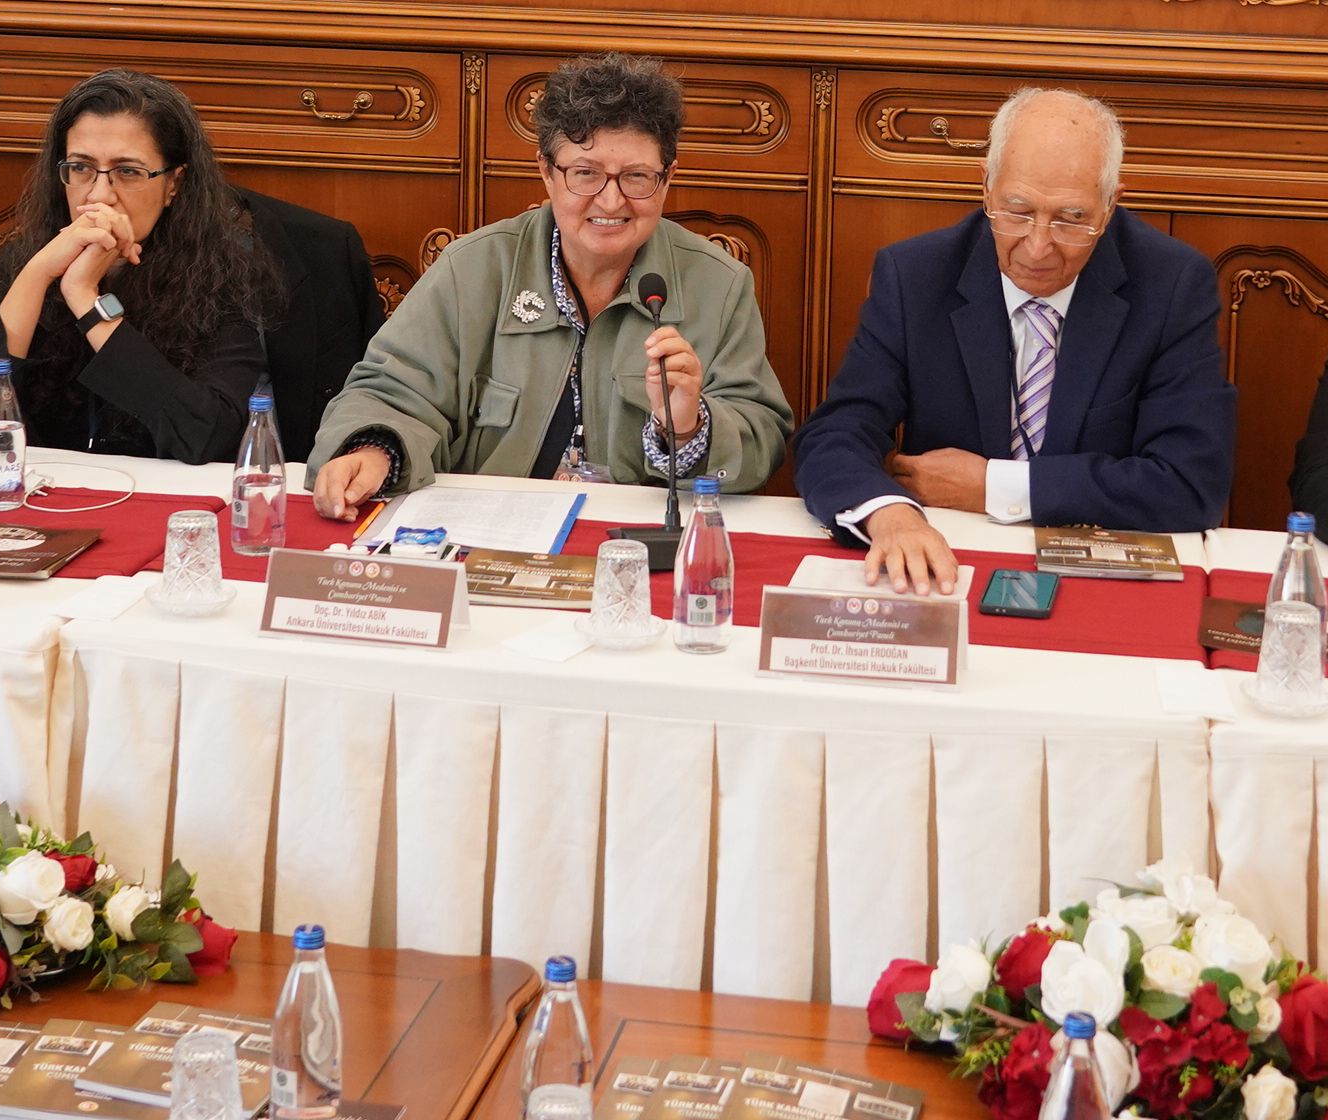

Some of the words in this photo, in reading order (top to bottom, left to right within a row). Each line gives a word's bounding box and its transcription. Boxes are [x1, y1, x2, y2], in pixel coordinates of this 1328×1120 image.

[314, 605, 330, 616] Doç.
[333, 606, 344, 616] Dr.
[286, 616, 314, 628] Ankara
[316, 619, 365, 632] Üniversitesi
[366, 623, 390, 634] Hukuk
[391, 625, 428, 639] Fakültesi
[811, 644, 830, 654] Prof.
[832, 645, 843, 655] Dr.
[845, 644, 869, 656] İhsan
[871, 646, 908, 659] ERDOĞAN
[784, 656, 817, 669] Başkent
[819, 658, 869, 671] Üniversitesi
[871, 661, 896, 672] Hukuk
[898, 663, 936, 675] Fakültesi
